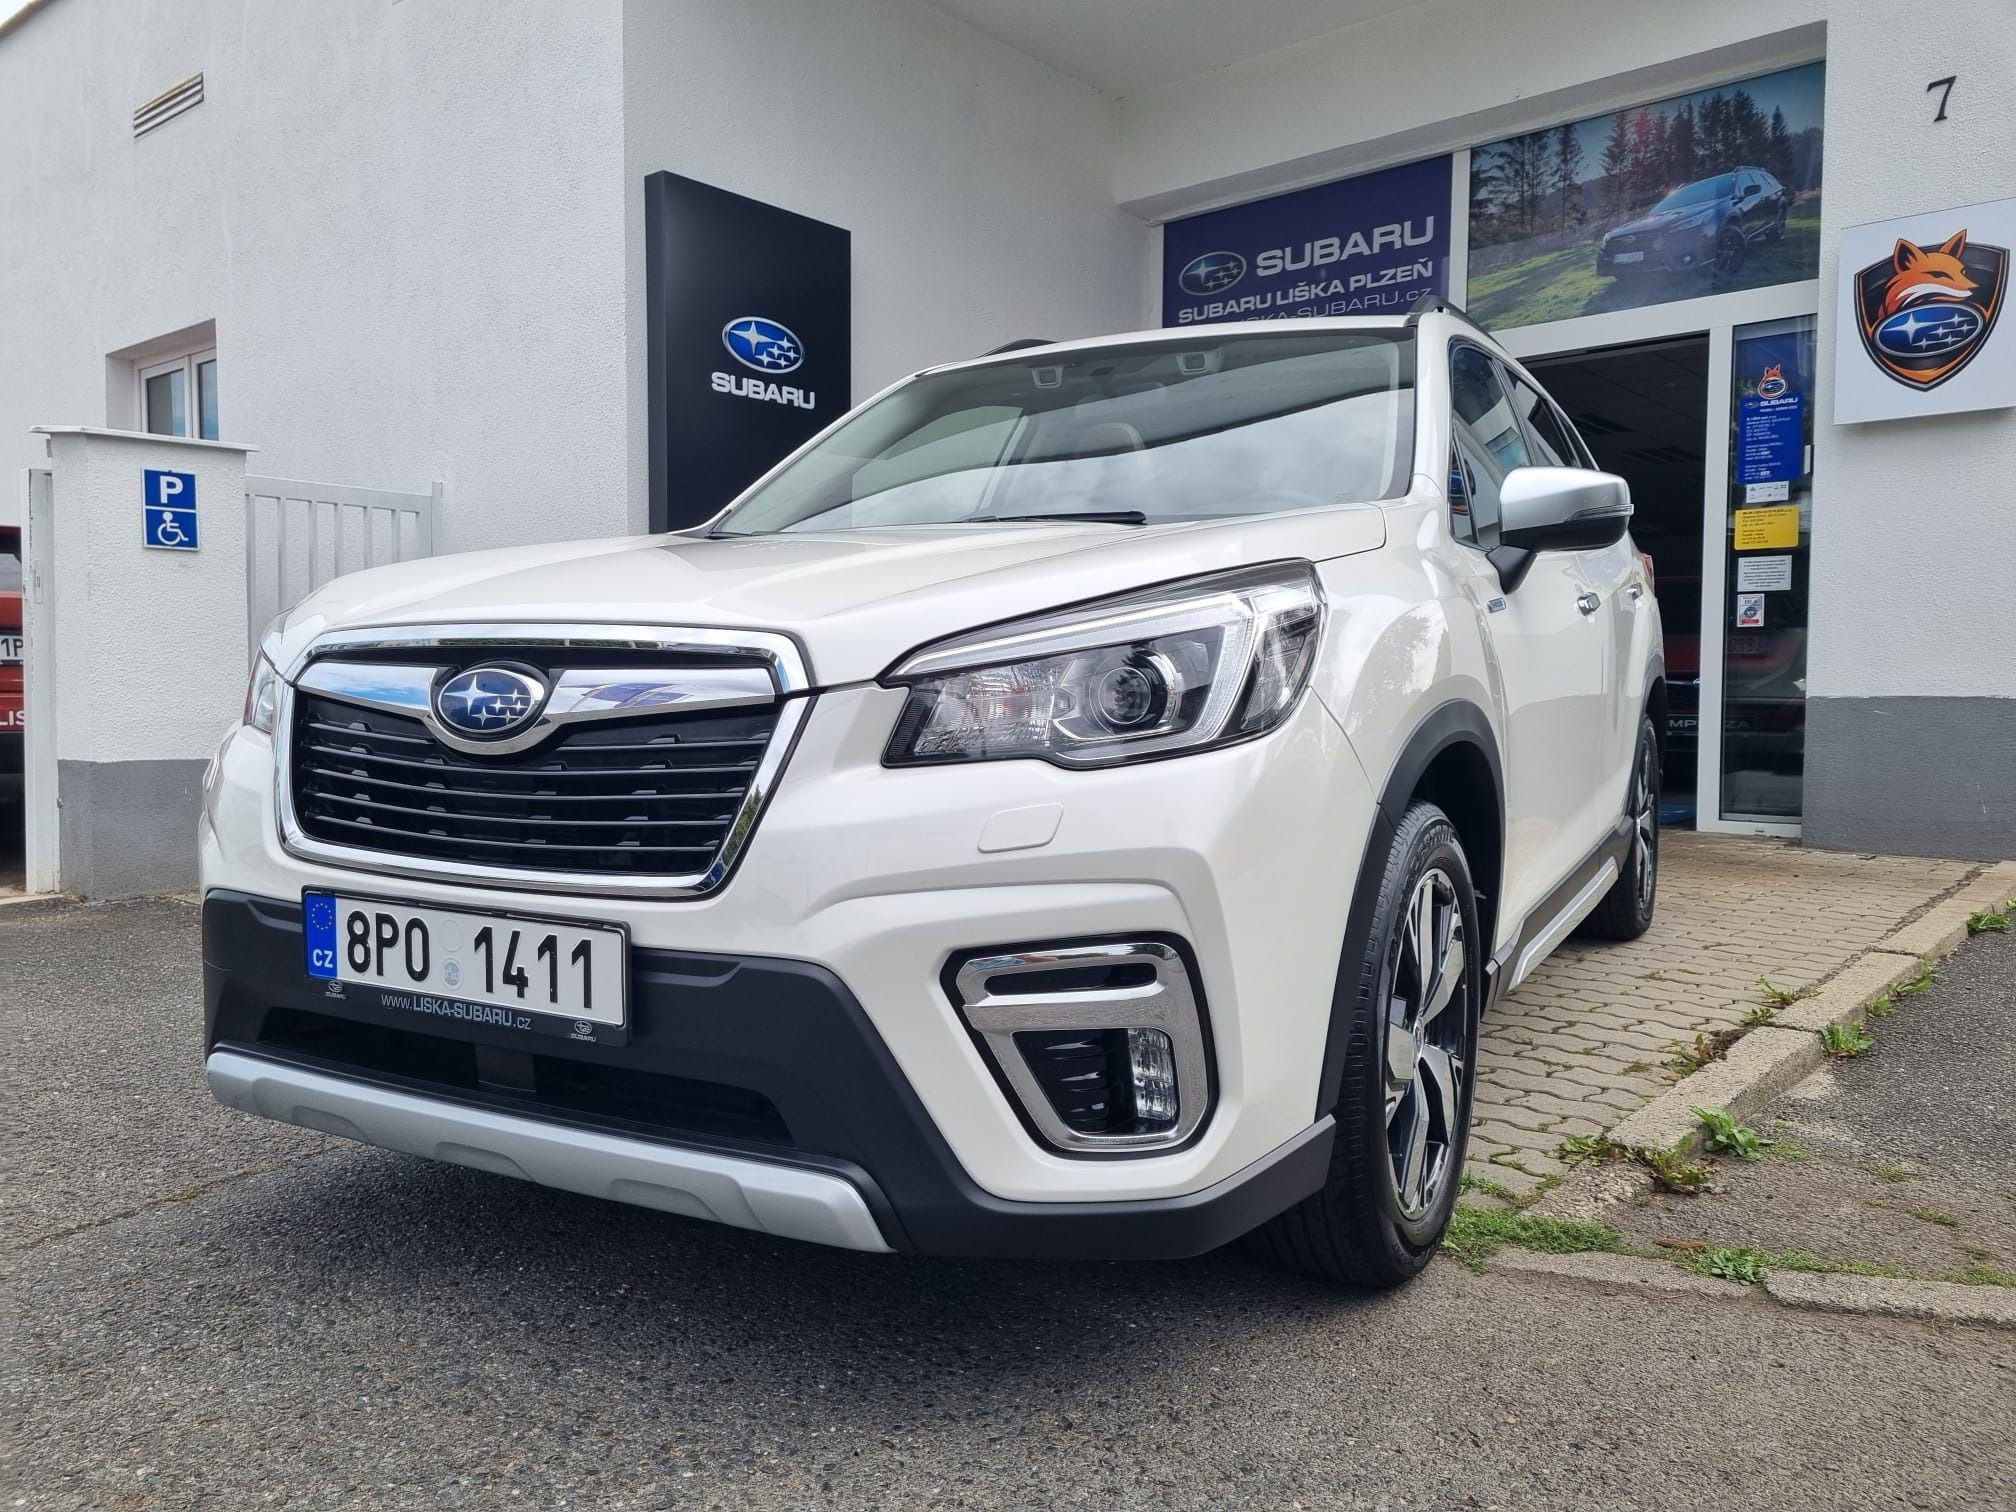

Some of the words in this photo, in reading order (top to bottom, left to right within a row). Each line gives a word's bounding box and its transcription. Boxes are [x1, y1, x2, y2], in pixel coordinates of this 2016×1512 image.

[1926, 75, 1957, 123] 7
[1256, 216, 1434, 277] SUBARU
[1178, 292, 1272, 324] SUBARU
[1276, 279, 1345, 306] LIŠKA
[1349, 257, 1433, 292] PLZEŇ
[711, 371, 815, 410] SUBARU
[159, 475, 183, 504] P
[312, 949, 334, 969] CZ
[474, 926, 592, 1010] 1411
